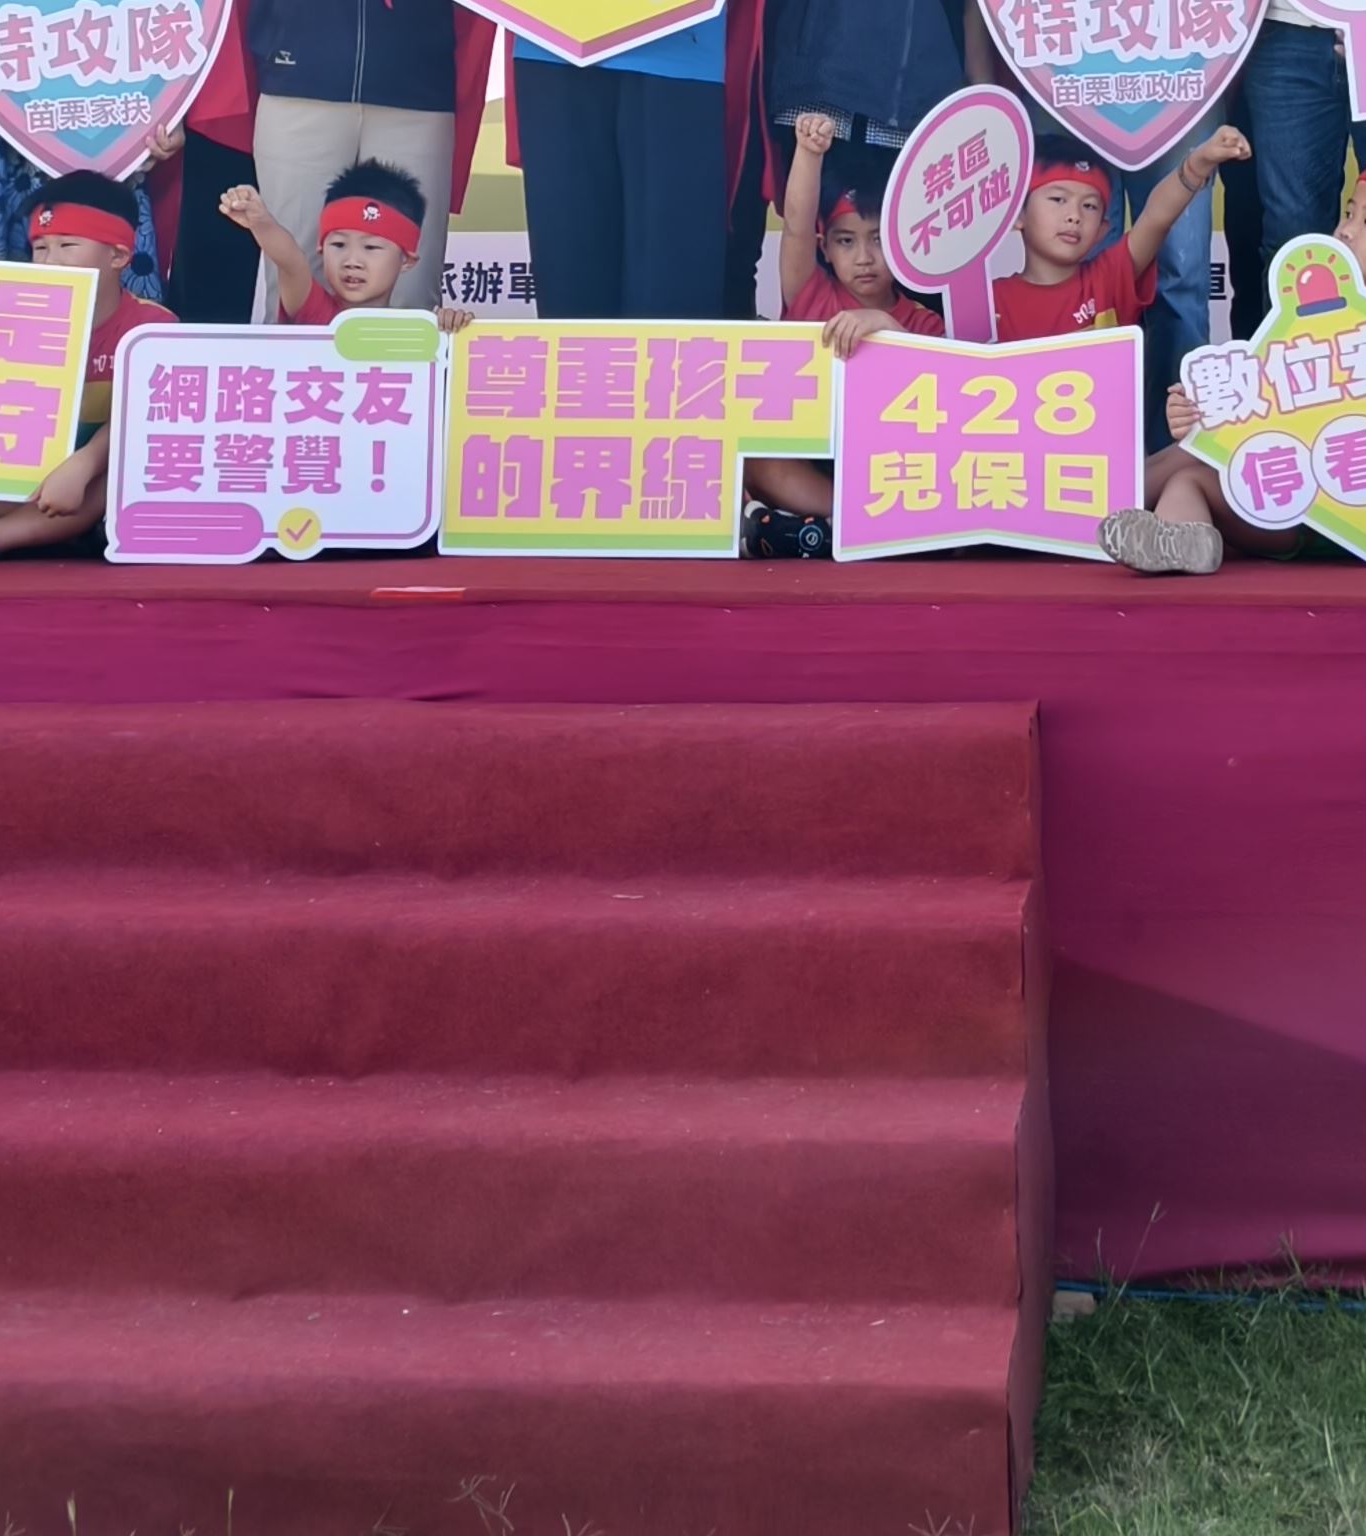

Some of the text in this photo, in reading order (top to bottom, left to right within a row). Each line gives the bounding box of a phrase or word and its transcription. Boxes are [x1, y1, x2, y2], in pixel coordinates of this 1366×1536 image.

[25, 93, 152, 135] 苗栗家扶
[1052, 71, 1205, 109] 苗栗縣政府
[923, 129, 990, 202] 禁區
[908, 163, 1012, 256] 不可碰
[145, 363, 413, 427] 網路交友
[465, 334, 820, 423] 尊重孩子
[880, 369, 1098, 435] 428
[143, 433, 388, 494] 要警覺！
[460, 433, 723, 520] 的界線
[864, 450, 1110, 518] 兒保日
